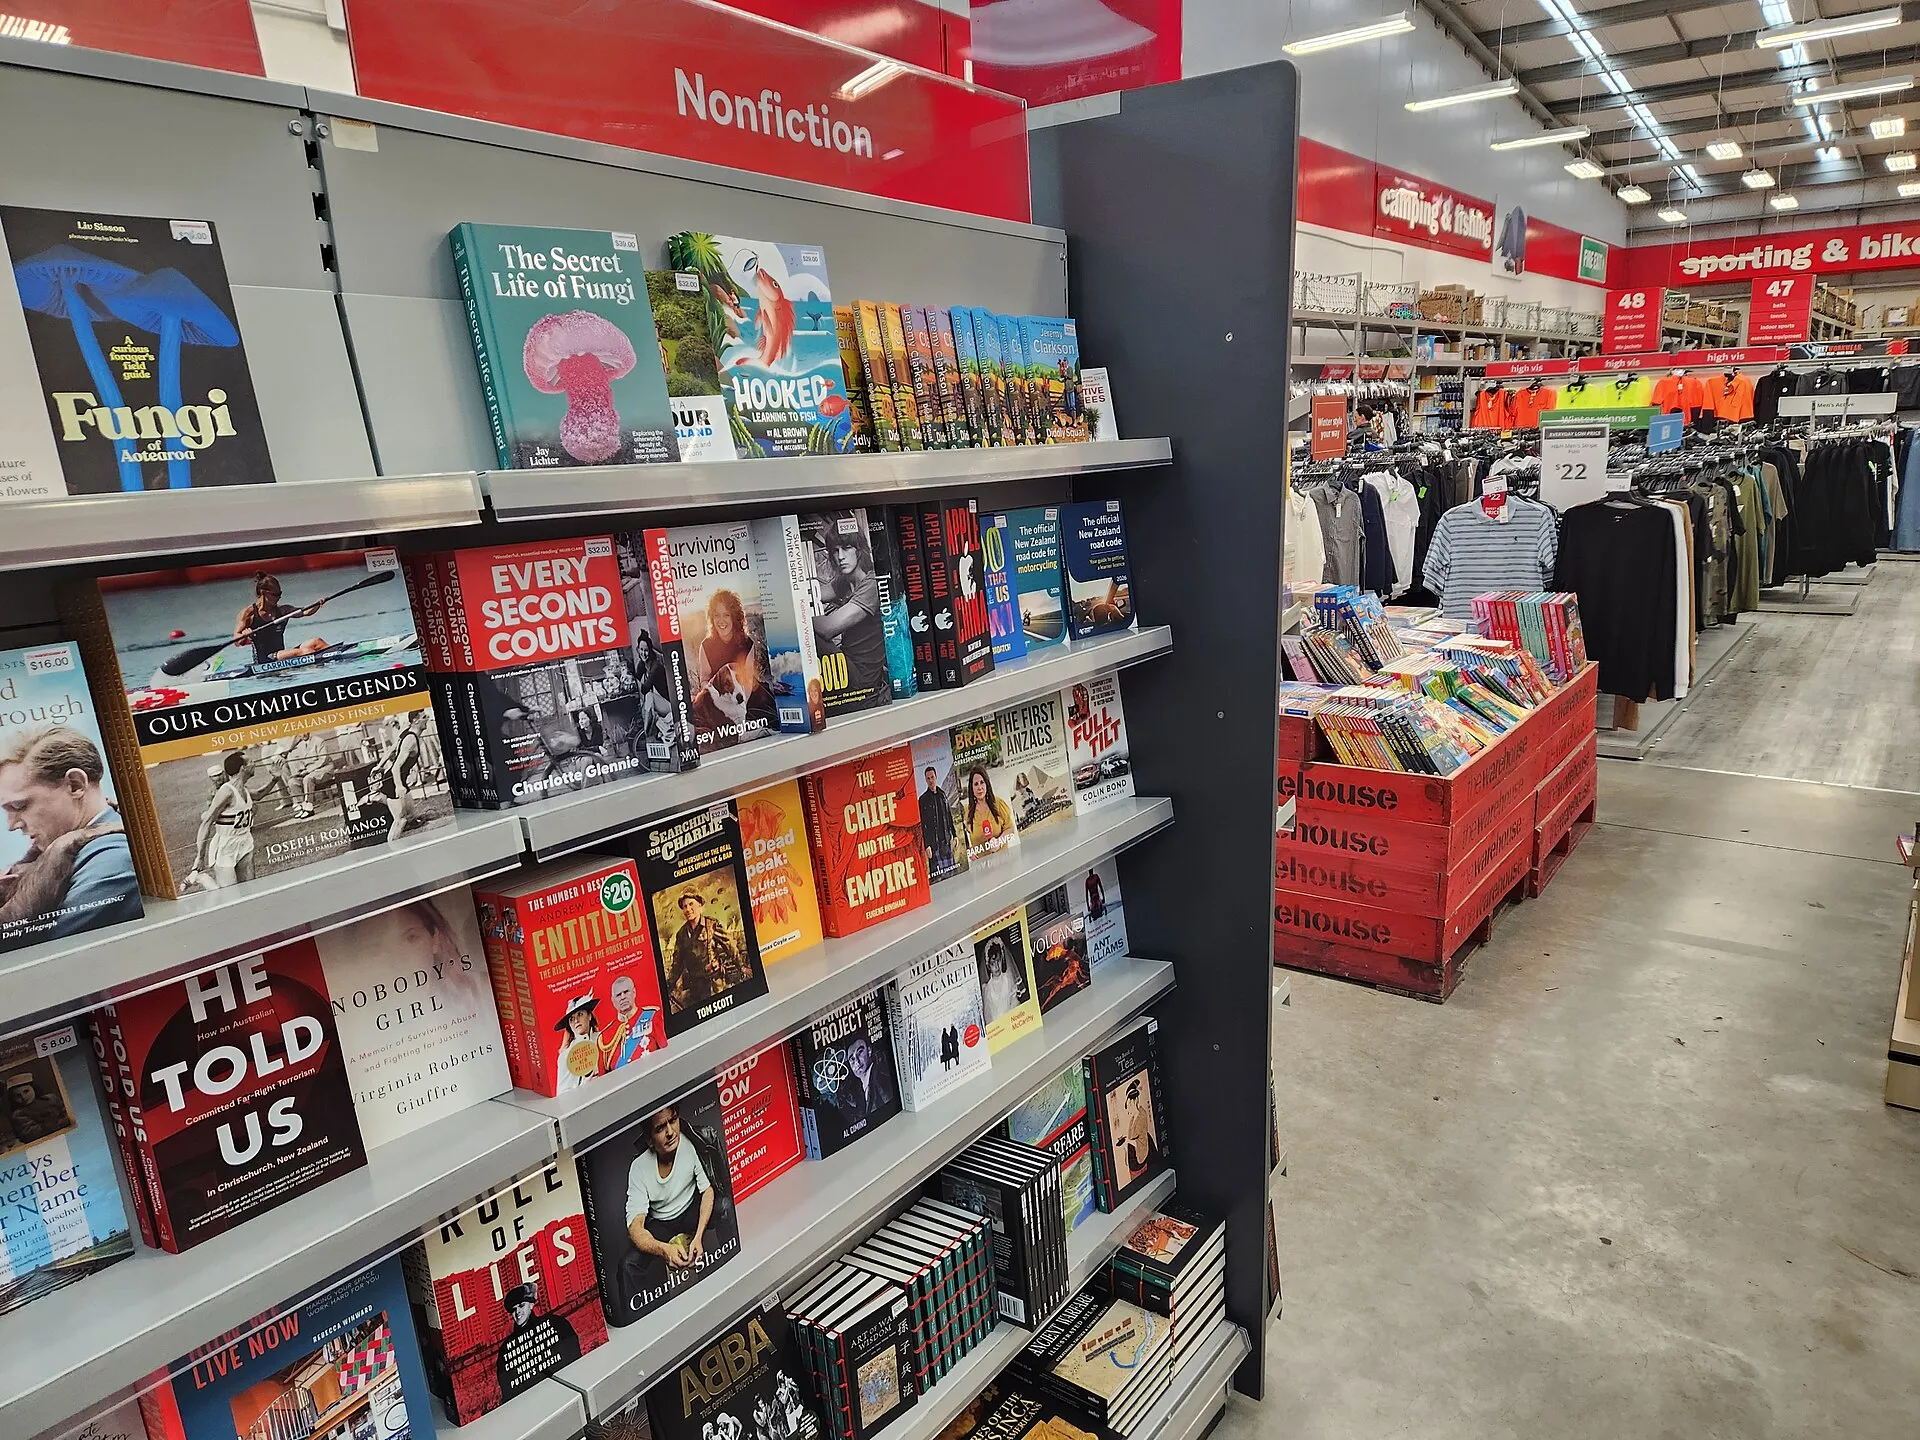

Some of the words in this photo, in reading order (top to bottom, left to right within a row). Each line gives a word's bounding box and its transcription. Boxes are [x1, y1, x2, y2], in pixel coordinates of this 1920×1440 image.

[674, 67, 873, 159] Nonfiction
[76, 221, 92, 231] Liv
[93, 222, 125, 232] Sisson
[1380, 186, 1440, 236] camping
[1441, 201, 1453, 232] &
[1454, 203, 1492, 248] fishing
[499, 244, 547, 270] The
[551, 246, 623, 274] Secret
[615, 240, 636, 249] $39.00
[1682, 243, 1814, 278] sporting
[1821, 238, 1849, 264] &
[492, 272, 539, 297] Life
[544, 274, 568, 299] of
[570, 275, 636, 305] Fungi
[1618, 293, 1645, 309] 48
[1766, 279, 1795, 297] 47
[111, 345, 149, 353] curious
[124, 336, 133, 344] A
[1033, 340, 1075, 355] Clarkson
[1040, 328, 1063, 340] Jeremy
[110, 352, 155, 361] forager's
[123, 361, 146, 370] field
[1511, 364, 1529, 374] high
[1531, 364, 1543, 372] vis
[1604, 359, 1625, 369] high
[1627, 358, 1640, 367] vis
[1707, 353, 1729, 362] high
[1731, 352, 1745, 360] vis
[122, 370, 151, 379] guide
[732, 375, 827, 412] HOOKED
[52, 389, 237, 449] Fungi
[752, 412, 787, 423] LEARNING
[788, 412, 799, 422] TO
[800, 411, 817, 421] FISH
[1046, 427, 1065, 439] Diddly
[1065, 428, 1085, 438] Squat
[1318, 418, 1332, 427] Winter
[1332, 417, 1343, 427] style
[121, 450, 196, 463] Aotearoa
[147, 440, 162, 450] of
[530, 456, 559, 466] Lichter
[535, 446, 550, 457] Jay
[6, 486, 48, 497] flowers
[945, 508, 980, 556] APPLE
[1015, 540, 1029, 550] New
[1030, 535, 1056, 547] Zealand
[1019, 526, 1031, 536] The
[1032, 522, 1056, 535] official
[1090, 540, 1105, 550] road
[1105, 537, 1122, 547] code
[372, 559, 395, 567] $34.99
[588, 546, 611, 555] $32.00
[1015, 551, 1029, 562] road
[1030, 550, 1046, 559] code
[1047, 548, 1056, 557] for
[491, 554, 588, 594] EVERY
[1017, 560, 1058, 574] motorcycling
[482, 586, 612, 629] SECOND
[954, 589, 989, 644] CHINA
[489, 617, 617, 661] COUNTS
[30, 656, 69, 671] $16.00
[149, 711, 209, 736] OUR
[214, 690, 318, 725] OLYMPIC
[325, 670, 418, 703] LEGENDS
[997, 708, 1020, 736] THE
[1021, 700, 1055, 728] FIRST
[211, 736, 226, 747] 50
[228, 732, 246, 743] OF
[249, 724, 279, 739] NEW
[283, 712, 345, 732] ZEALAND'S
[348, 703, 386, 720] FINEST
[955, 724, 996, 750] BRAVE
[1007, 725, 1053, 757] ANZACS
[1073, 707, 1112, 750] FULL
[1089, 718, 1121, 758] TILT
[511, 770, 582, 797] Charlotte
[585, 756, 639, 778] Glennie
[856, 769, 876, 788] THE
[1082, 784, 1105, 802] COLIN
[1106, 778, 1127, 795] BOND
[1277, 772, 1398, 810] ehouse
[843, 792, 898, 835] CHIEF
[265, 835, 316, 859] JOSEPH
[320, 814, 388, 843] ROMANOS
[646, 846, 661, 857] FOR
[662, 819, 723, 861] CHARLIE
[754, 828, 795, 857] Dead
[857, 840, 876, 860] AND
[876, 833, 895, 853] THE
[1473, 817, 1522, 877] warehouse
[603, 879, 632, 905] $26
[758, 877, 776, 894] Life
[776, 875, 787, 888] in
[846, 856, 918, 908] EMPIRE
[1274, 857, 1388, 897] ehouse
[528, 898, 545, 912] THE
[547, 886, 579, 906] NUMBER
[581, 884, 585, 894] 1
[531, 899, 642, 967] ENTITLED
[1274, 904, 1392, 944] ehouse
[331, 953, 473, 1016] NOBODY'S
[903, 961, 977, 1007] MARGARETE
[375, 995, 444, 1031] GIRL
[696, 1003, 712, 1020] TOM
[713, 995, 734, 1014] SCOTT
[197, 1027, 217, 1041] How
[219, 1023, 231, 1033] an
[232, 1007, 275, 1029] Australian
[350, 1056, 356, 1064] A
[359, 1044, 393, 1060] Memoir
[396, 1037, 404, 1046] of
[407, 1023, 449, 1041] Surviving
[450, 1012, 478, 1026] Abuse
[812, 1011, 863, 1050] PROJECT
[151, 1015, 324, 1113] TOLD
[365, 1061, 381, 1073] and
[383, 1047, 421, 1067] Fighting
[423, 1041, 436, 1051] for
[438, 1028, 469, 1045] Justice
[185, 1099, 236, 1126] Committed
[236, 1083, 277, 1107] Far-Right
[277, 1066, 316, 1090] Terrorism
[396, 1081, 459, 1115] Giuffre
[216, 1096, 303, 1166] US
[15, 1183, 88, 1222] Name
[491, 1215, 525, 1252] OF
[451, 1226, 576, 1321] LIES
[629, 1267, 690, 1311] Charlie
[694, 1236, 737, 1274] Sheen
[307, 1303, 329, 1317] WORK
[330, 1293, 350, 1309] HARD
[350, 1284, 364, 1297] FOR
[365, 1274, 380, 1287] YOU
[506, 1340, 516, 1350] MY
[517, 1329, 535, 1344] WILD
[536, 1319, 551, 1335] RIDE
[858, 1324, 892, 1350] WISDOM
[191, 1346, 244, 1390] LIVE
[248, 1312, 300, 1360] NOW
[517, 1355, 543, 1375] MURDER
[544, 1348, 552, 1360] IN
[680, 1318, 777, 1418] ABBA
